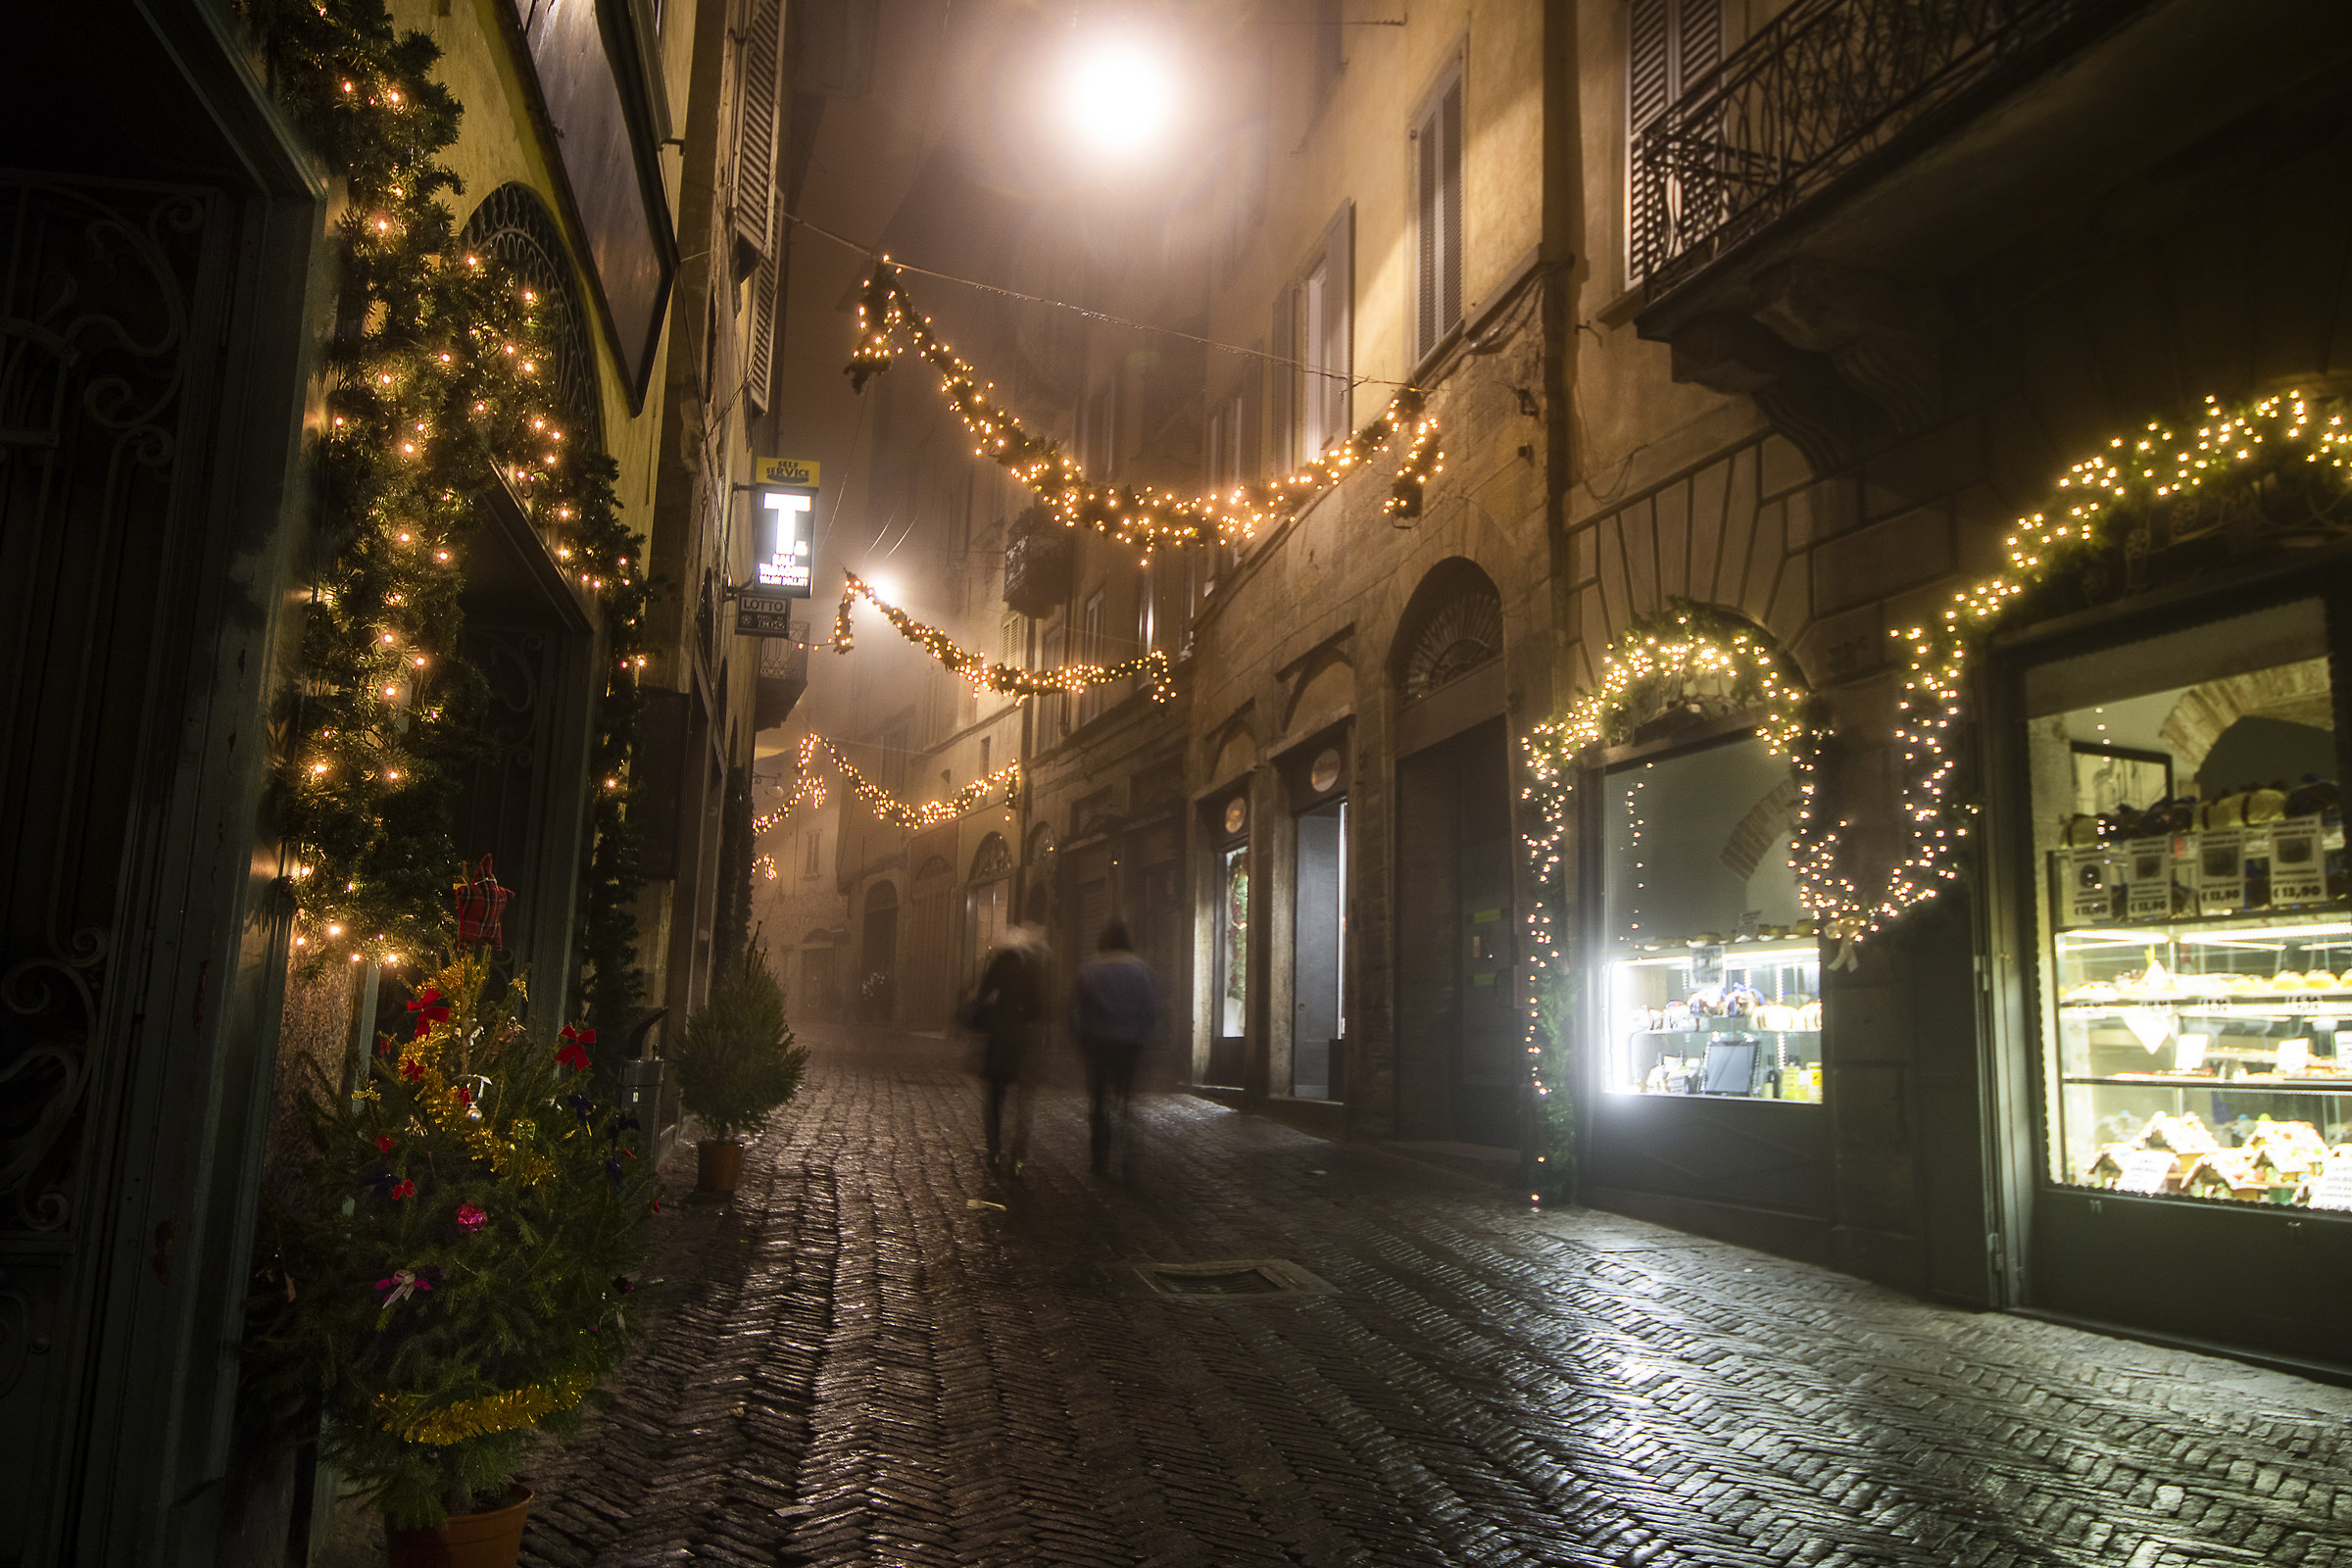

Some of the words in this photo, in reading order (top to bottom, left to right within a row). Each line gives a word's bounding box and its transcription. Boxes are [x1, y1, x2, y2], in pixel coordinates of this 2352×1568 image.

[766, 466, 809, 478] SERVICE
[763, 492, 811, 555] T
[743, 599, 784, 612] LOTTO
